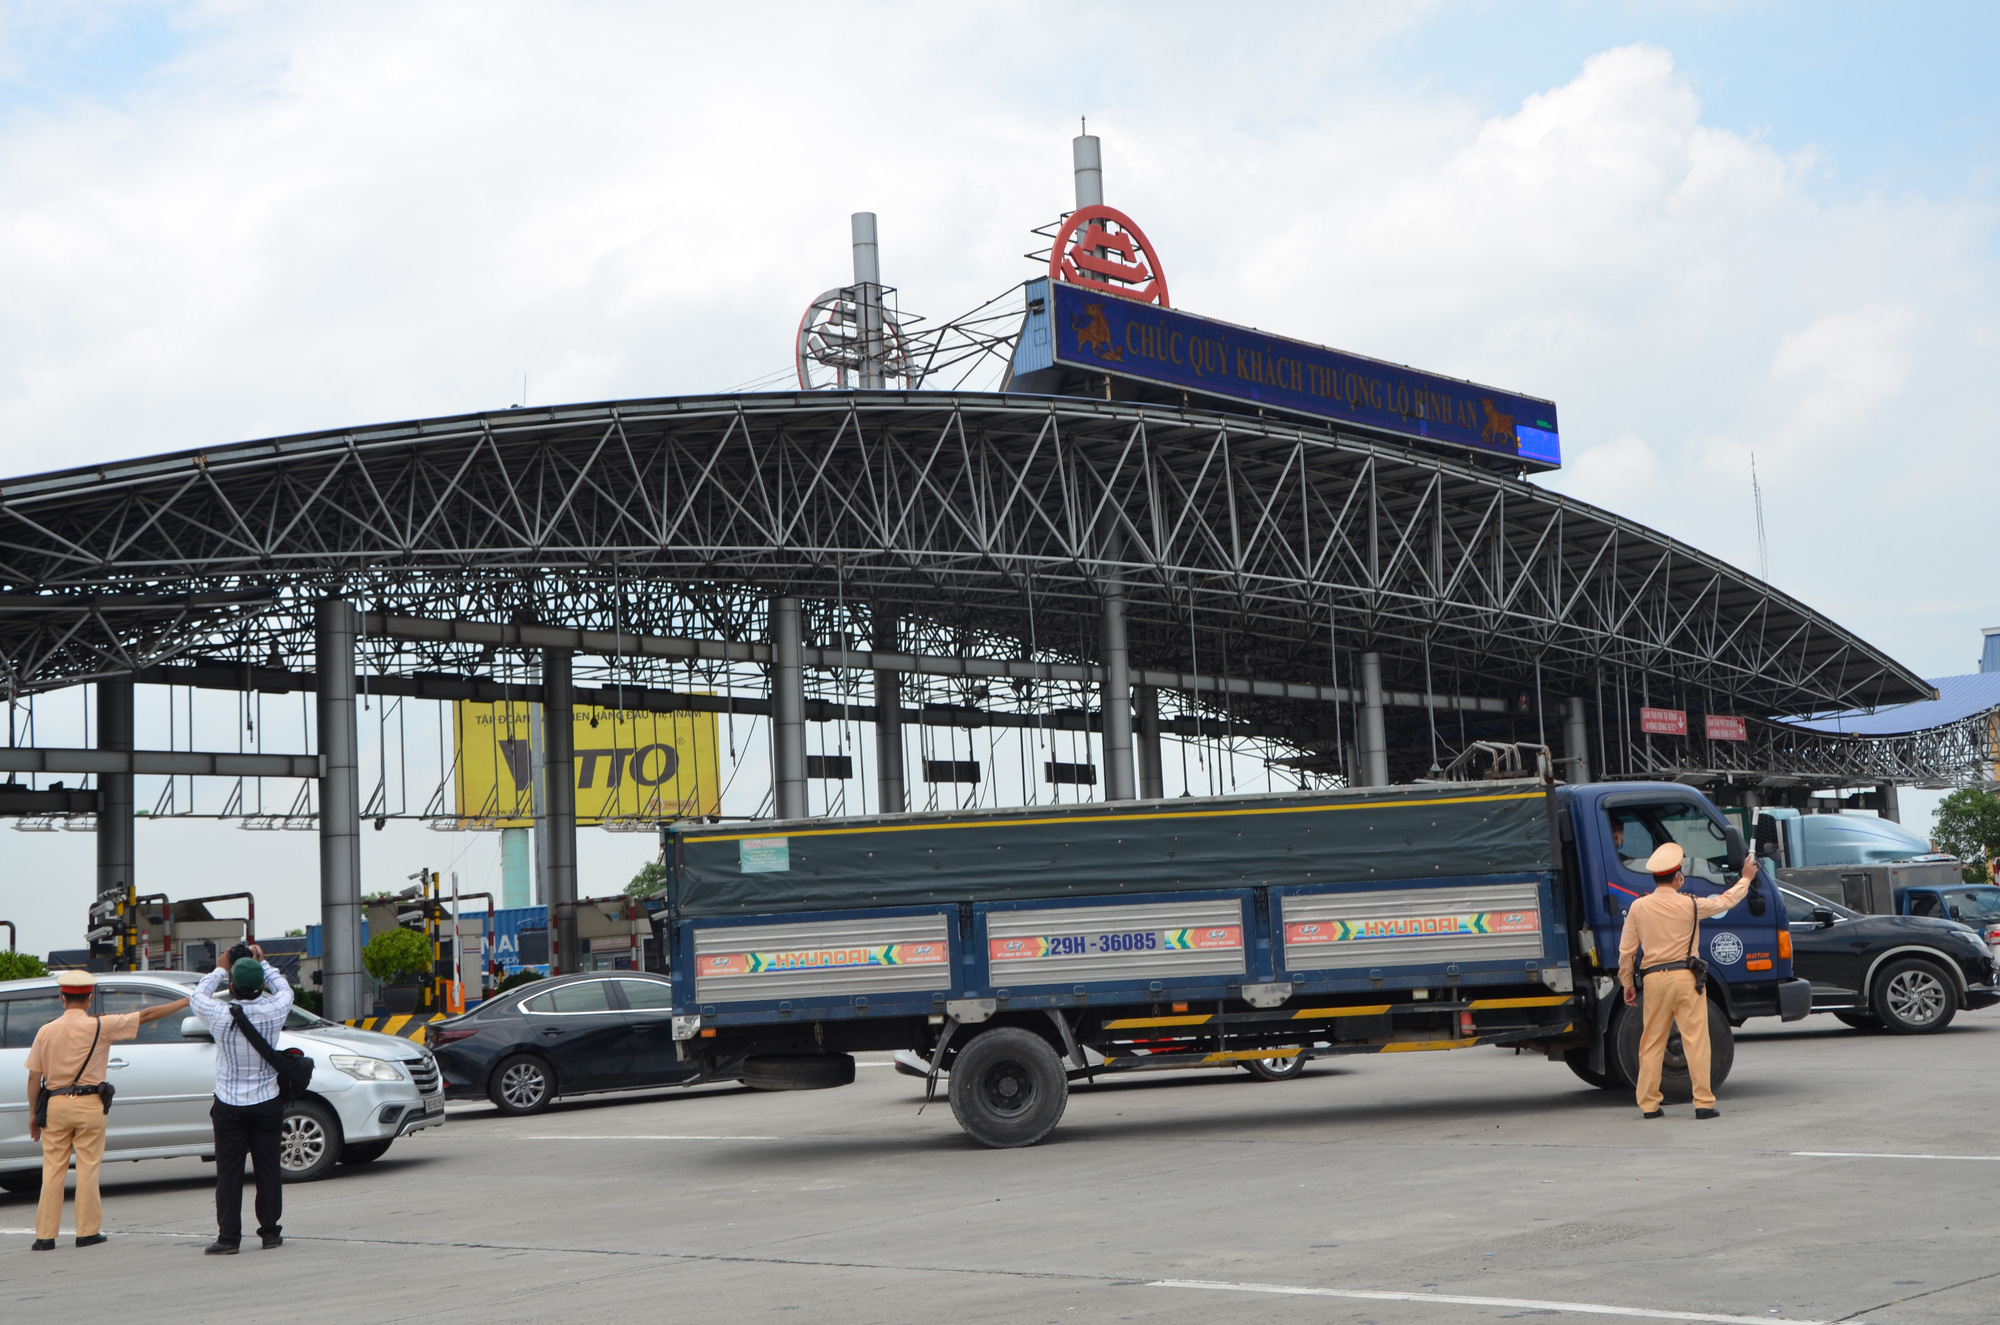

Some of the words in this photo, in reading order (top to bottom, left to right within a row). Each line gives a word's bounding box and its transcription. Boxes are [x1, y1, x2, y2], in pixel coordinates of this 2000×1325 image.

[1126, 319, 1184, 365] CHÚC
[1189, 334, 1229, 377] QUÝ
[1237, 345, 1303, 392] KHÁCH
[1307, 363, 1382, 411] THƯỢNG
[1387, 381, 1409, 423] LỘ
[1413, 383, 1453, 424] BÌNH
[1457, 400, 1478, 430] AN
[498, 739, 680, 791] VTTO
[1364, 917, 1459, 937] HYUNDAI
[1050, 936, 1086, 955] 29H
[1098, 932, 1156, 952] 36085
[775, 949, 869, 968] HYUNDAI
